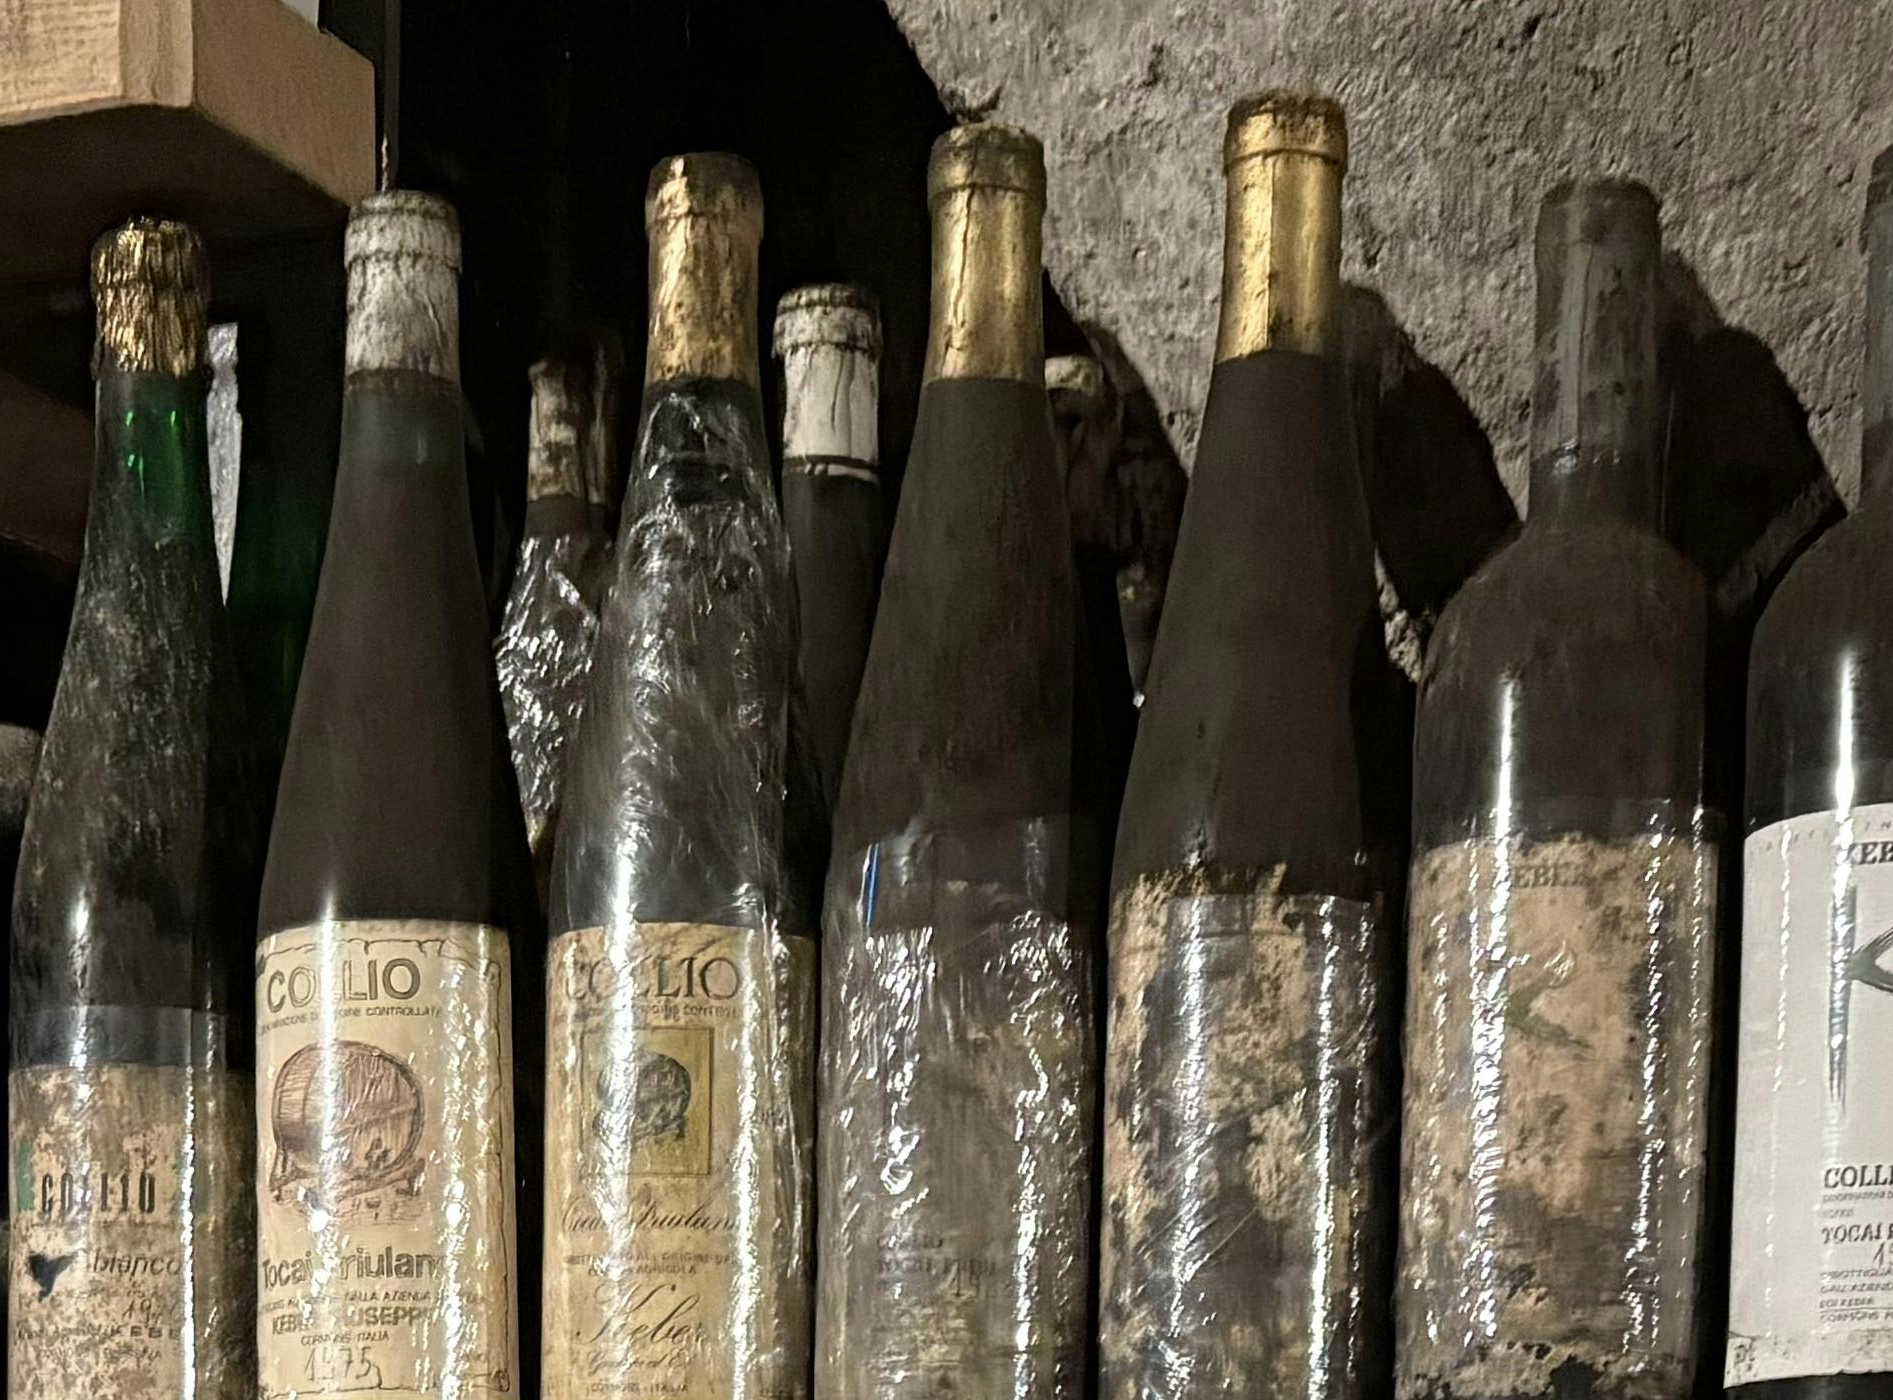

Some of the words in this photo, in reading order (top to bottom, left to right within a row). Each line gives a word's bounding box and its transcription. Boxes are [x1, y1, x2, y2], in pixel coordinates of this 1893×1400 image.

[267, 958, 422, 1014] COLIO
[1821, 1222, 1881, 1244] TOCAI
[92, 1249, 182, 1276] bianco
[261, 1251, 314, 1290] Tocai
